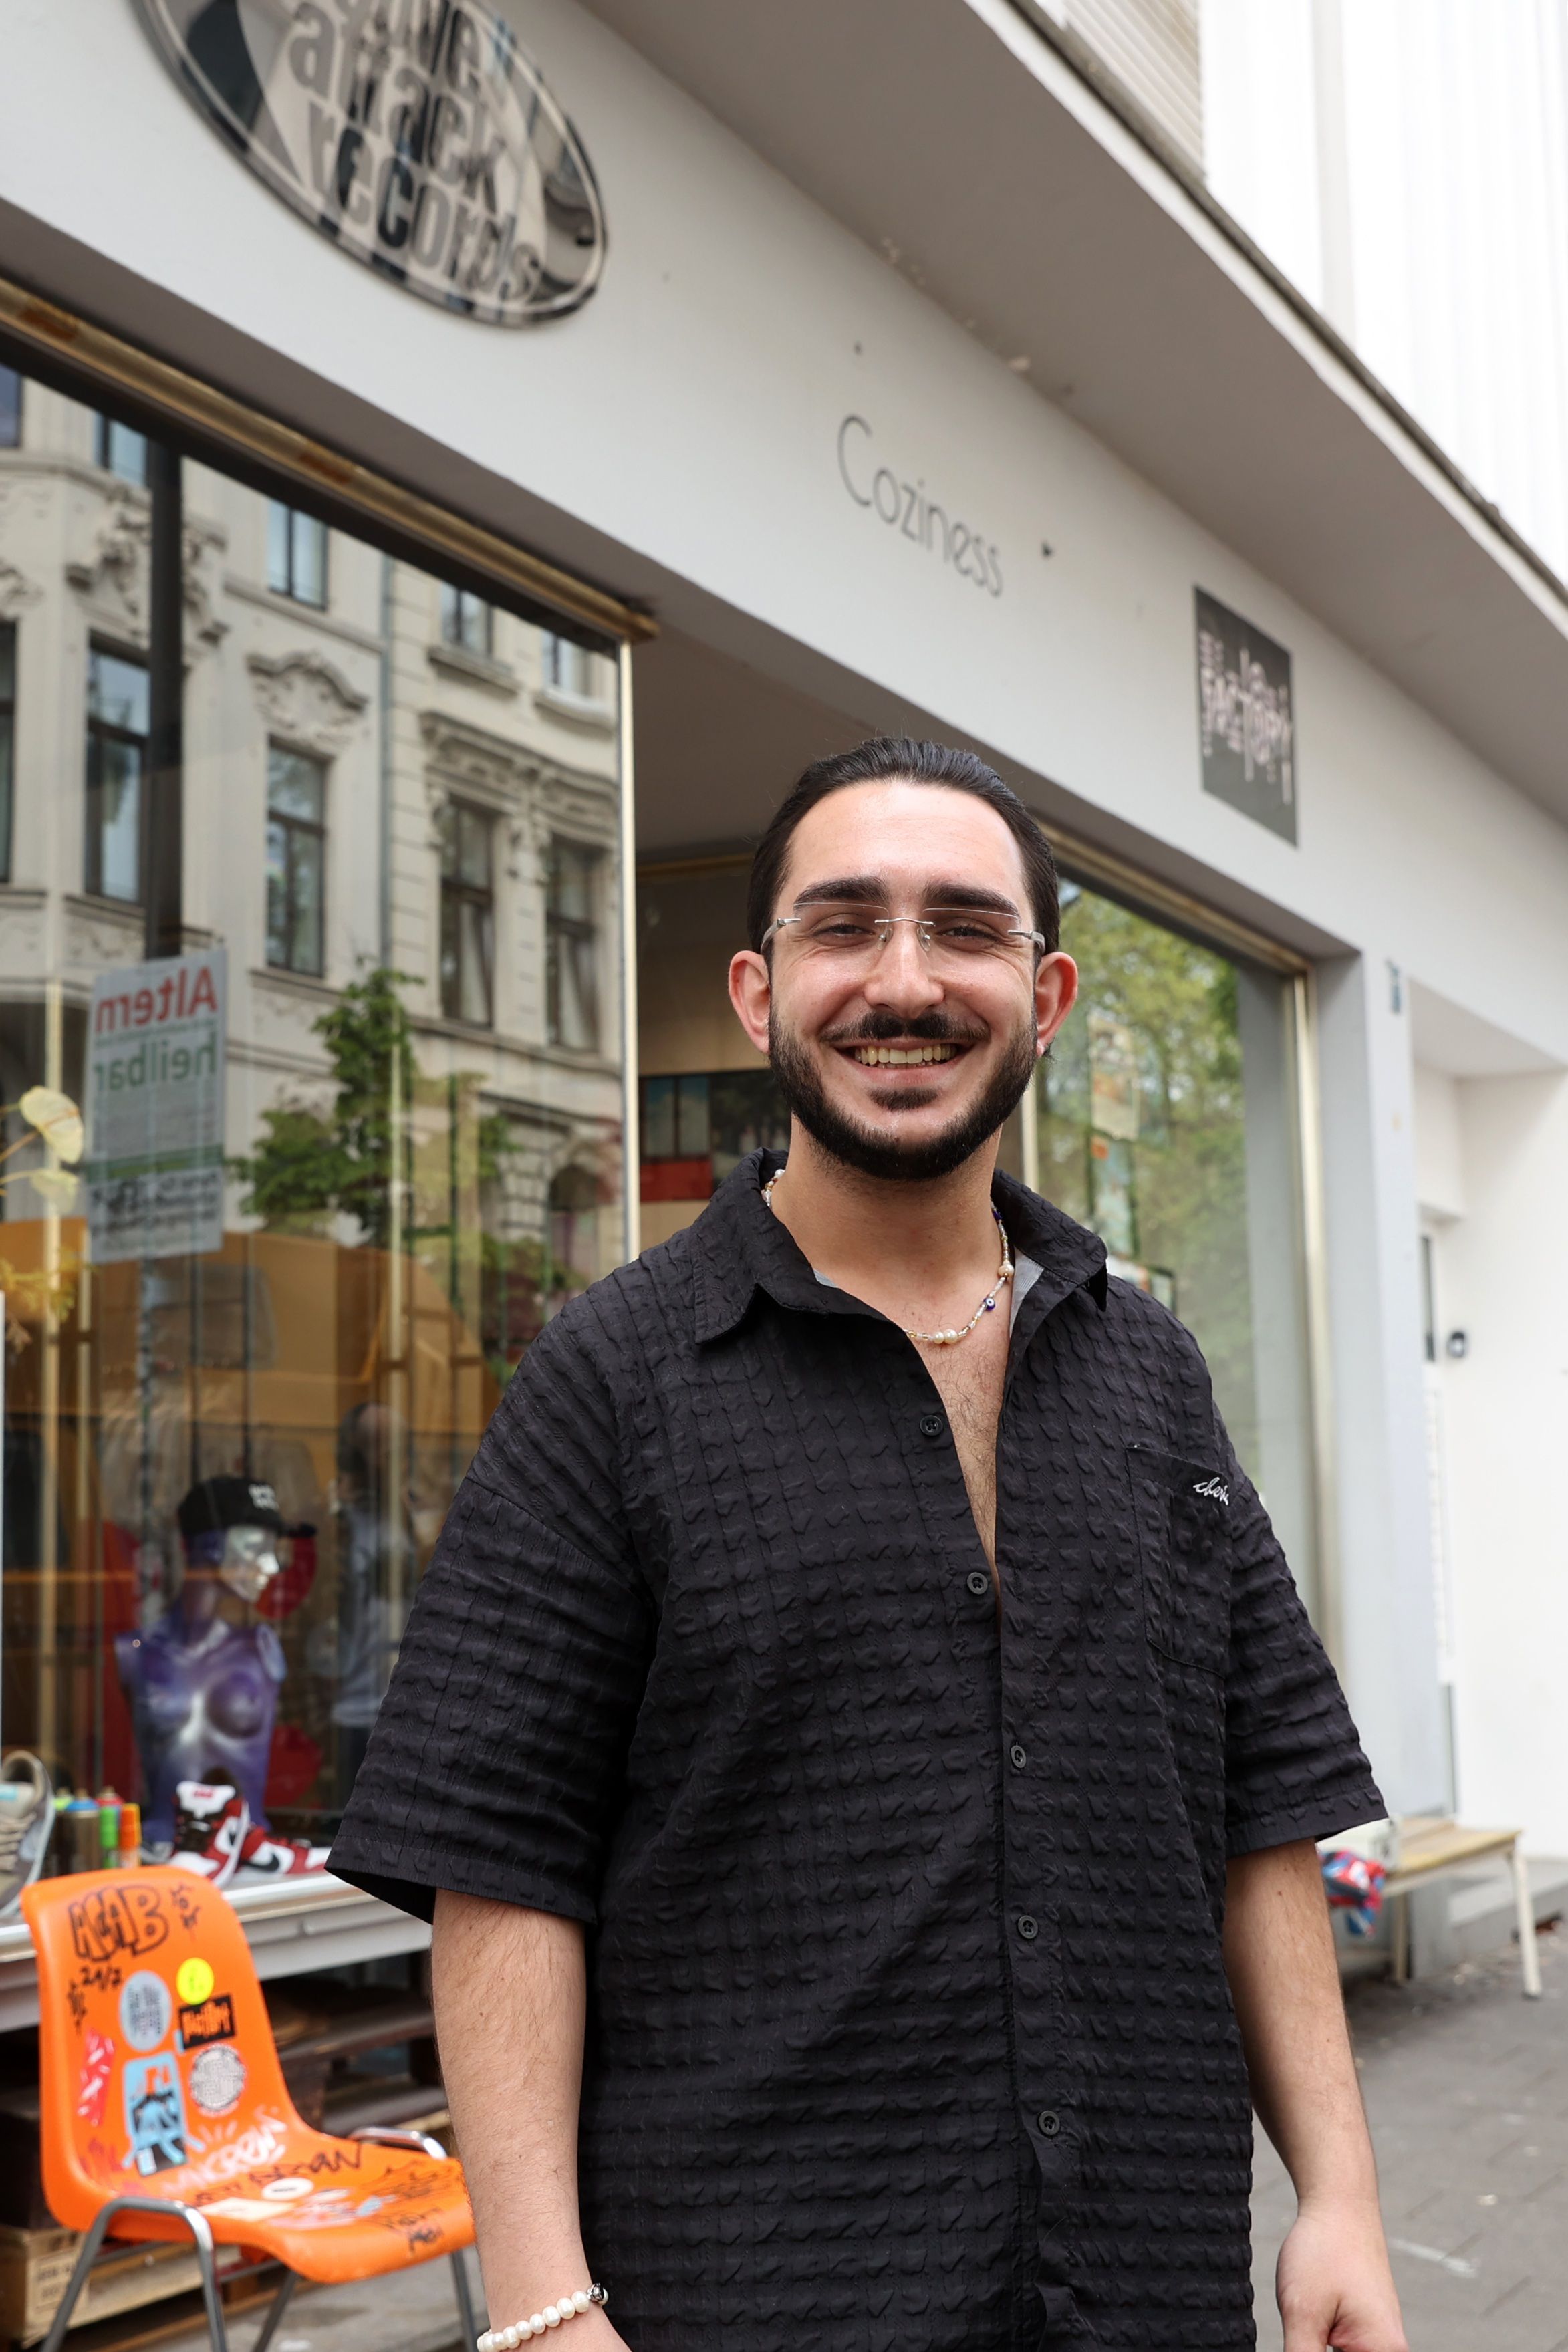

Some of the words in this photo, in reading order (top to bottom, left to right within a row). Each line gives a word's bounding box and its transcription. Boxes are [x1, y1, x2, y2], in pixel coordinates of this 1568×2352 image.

[289, 3, 506, 215] attack
[308, 100, 540, 301] records
[837, 412, 1003, 598] Coziness
